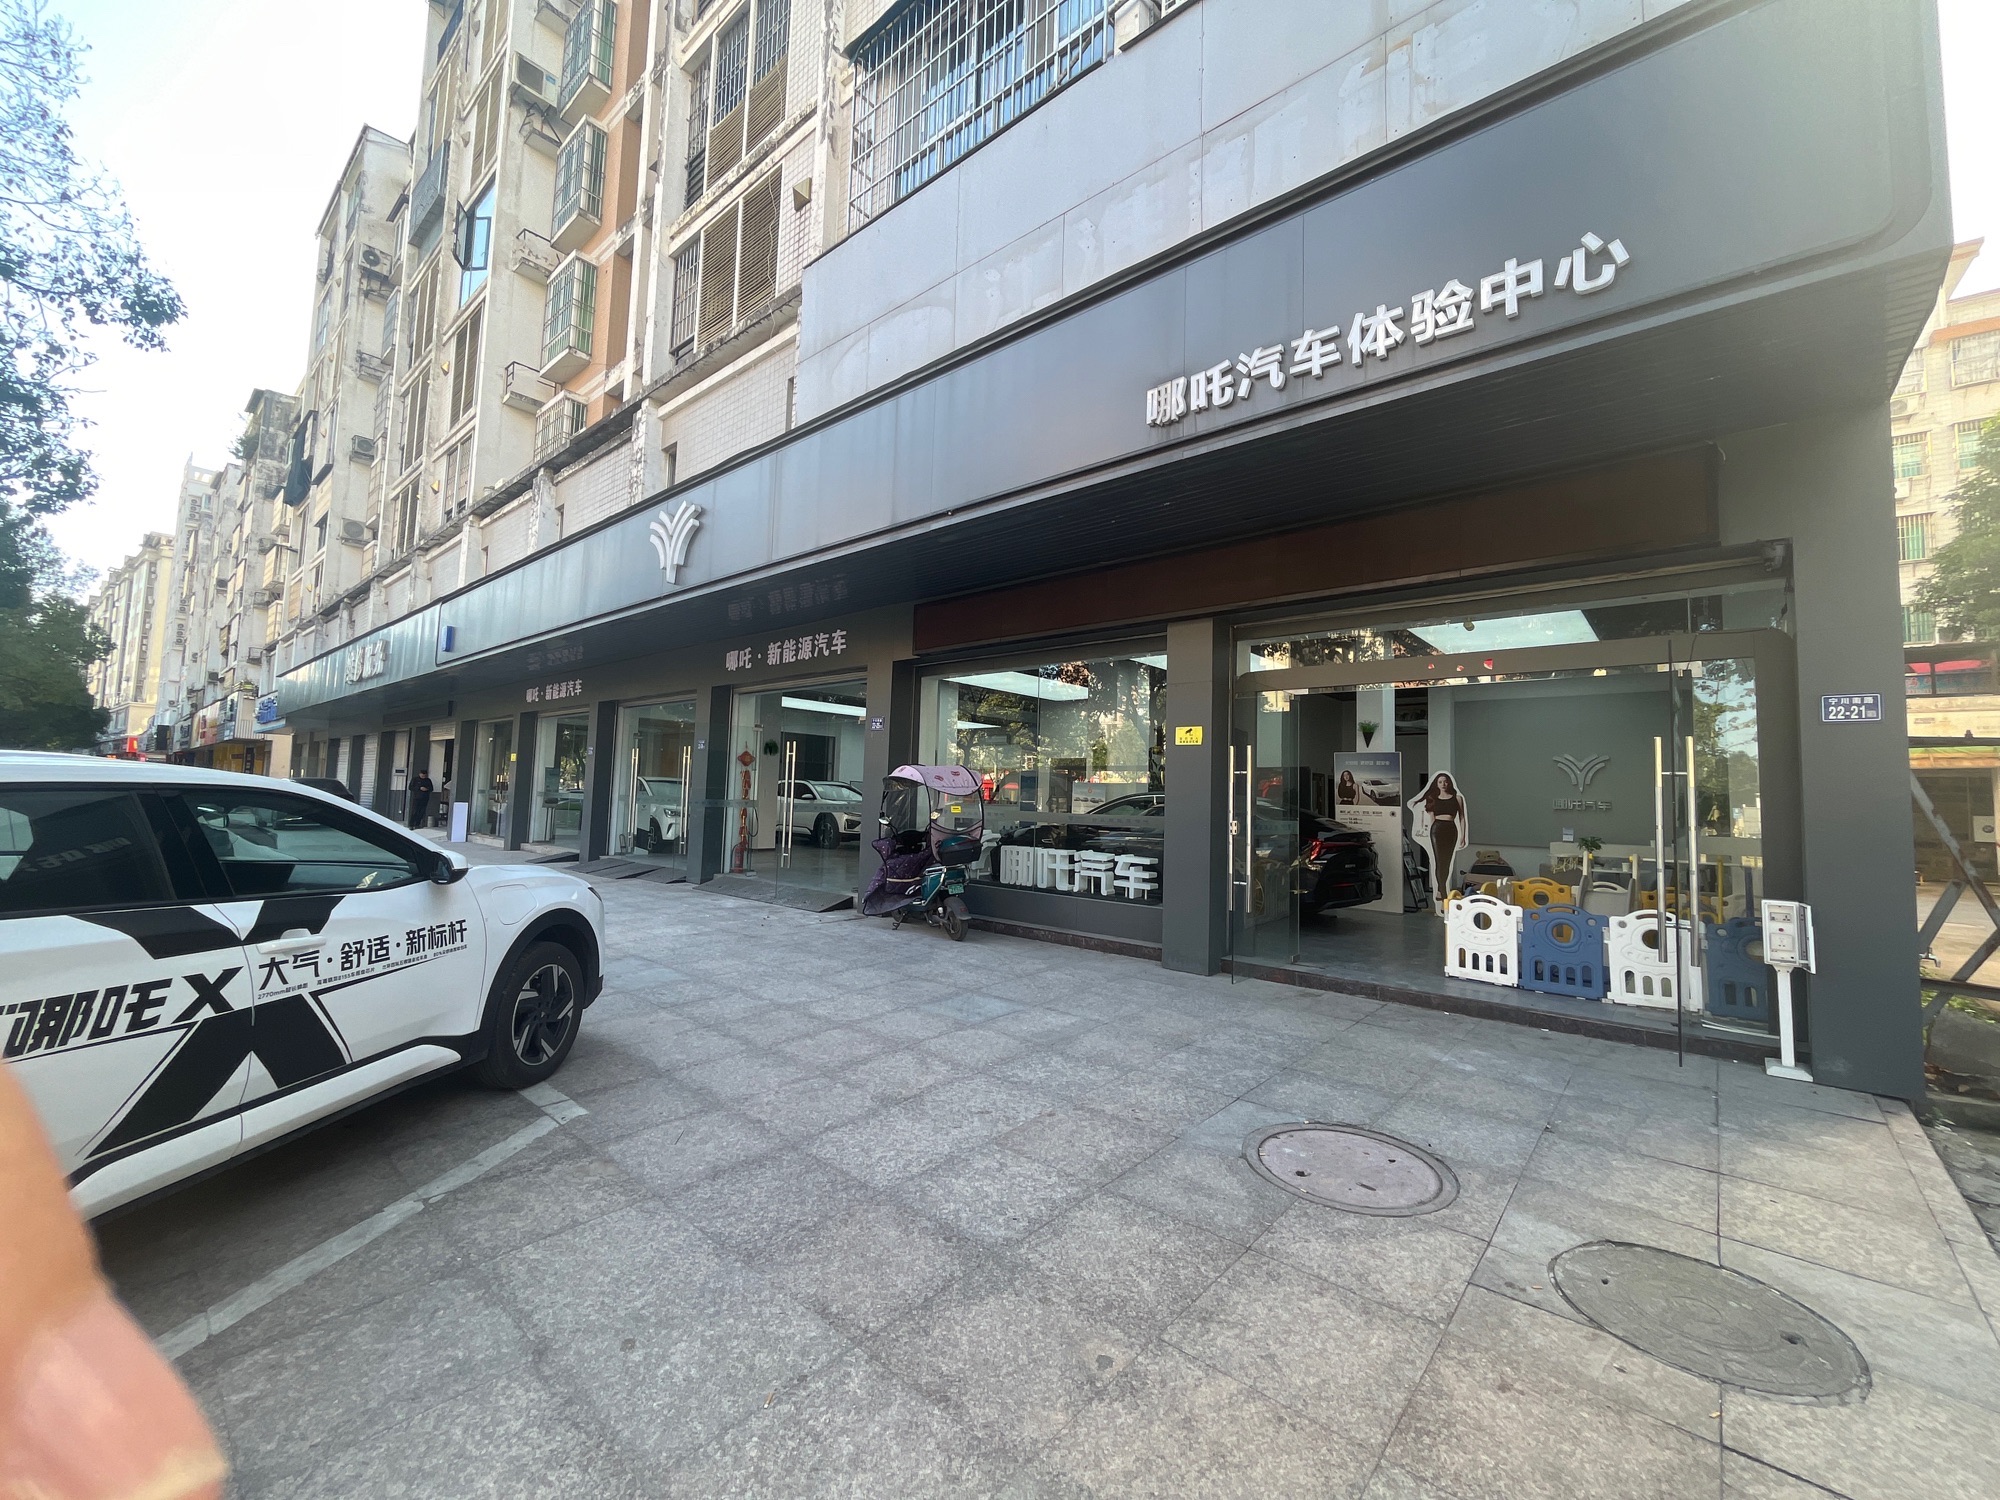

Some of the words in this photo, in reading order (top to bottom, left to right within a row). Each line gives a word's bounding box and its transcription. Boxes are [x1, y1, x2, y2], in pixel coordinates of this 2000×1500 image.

[1145, 231, 1630, 428] 哪吒汽车体验中心
[725, 629, 847, 671] 哪吒·新能源汽车
[1000, 845, 1158, 899] 哪吒汽车
[258, 919, 468, 991] 大气·舒适·新标杆
